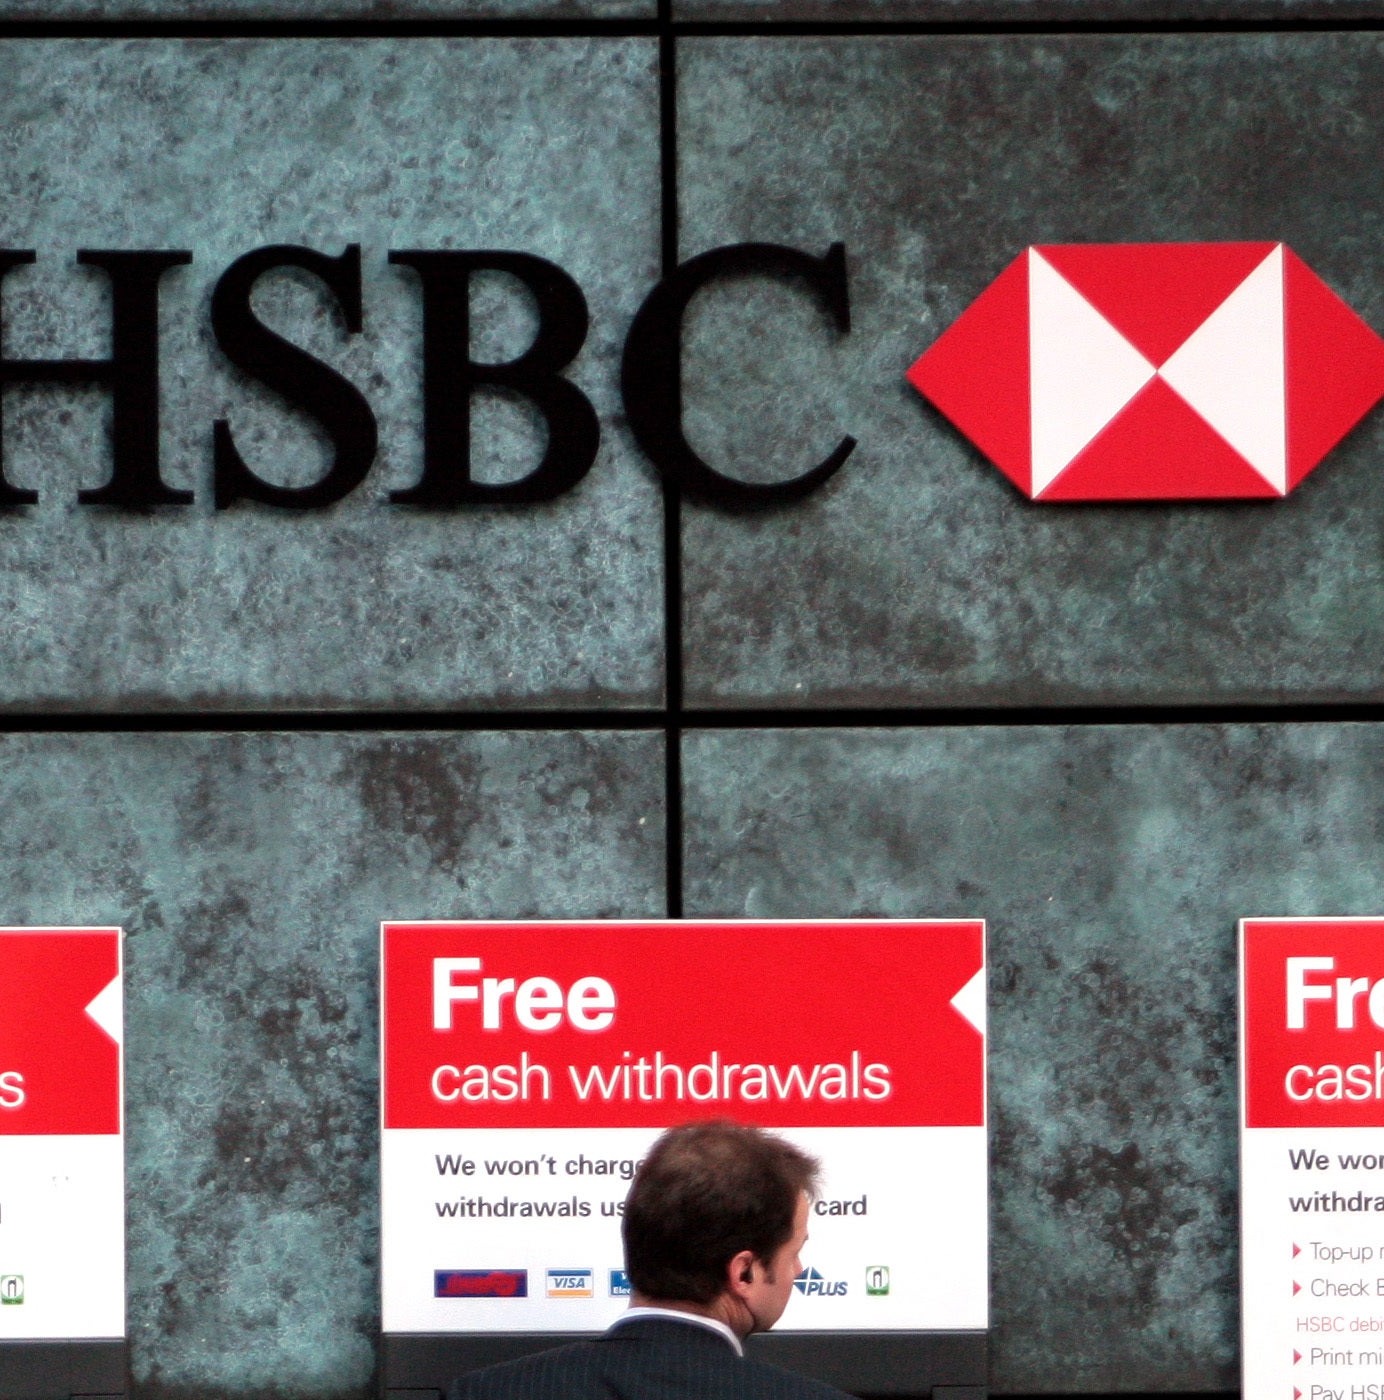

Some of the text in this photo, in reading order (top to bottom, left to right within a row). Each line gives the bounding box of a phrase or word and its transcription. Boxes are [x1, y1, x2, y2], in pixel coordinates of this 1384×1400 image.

[434, 958, 615, 1031] Free
[432, 1051, 890, 1101] cash withdrawals
[436, 1155, 475, 1176] We
[485, 1155, 556, 1175] won't
[1288, 1148, 1330, 1171] We
[436, 1196, 591, 1217] withdrawals
[814, 1194, 867, 1216] card
[1309, 1241, 1374, 1265] Top-up
[554, 1278, 586, 1289] VISA
[806, 1281, 849, 1297] PLUS
[1310, 1277, 1370, 1298] Check
[1296, 1316, 1345, 1333] HSBC
[1310, 1347, 1353, 1366] Print
